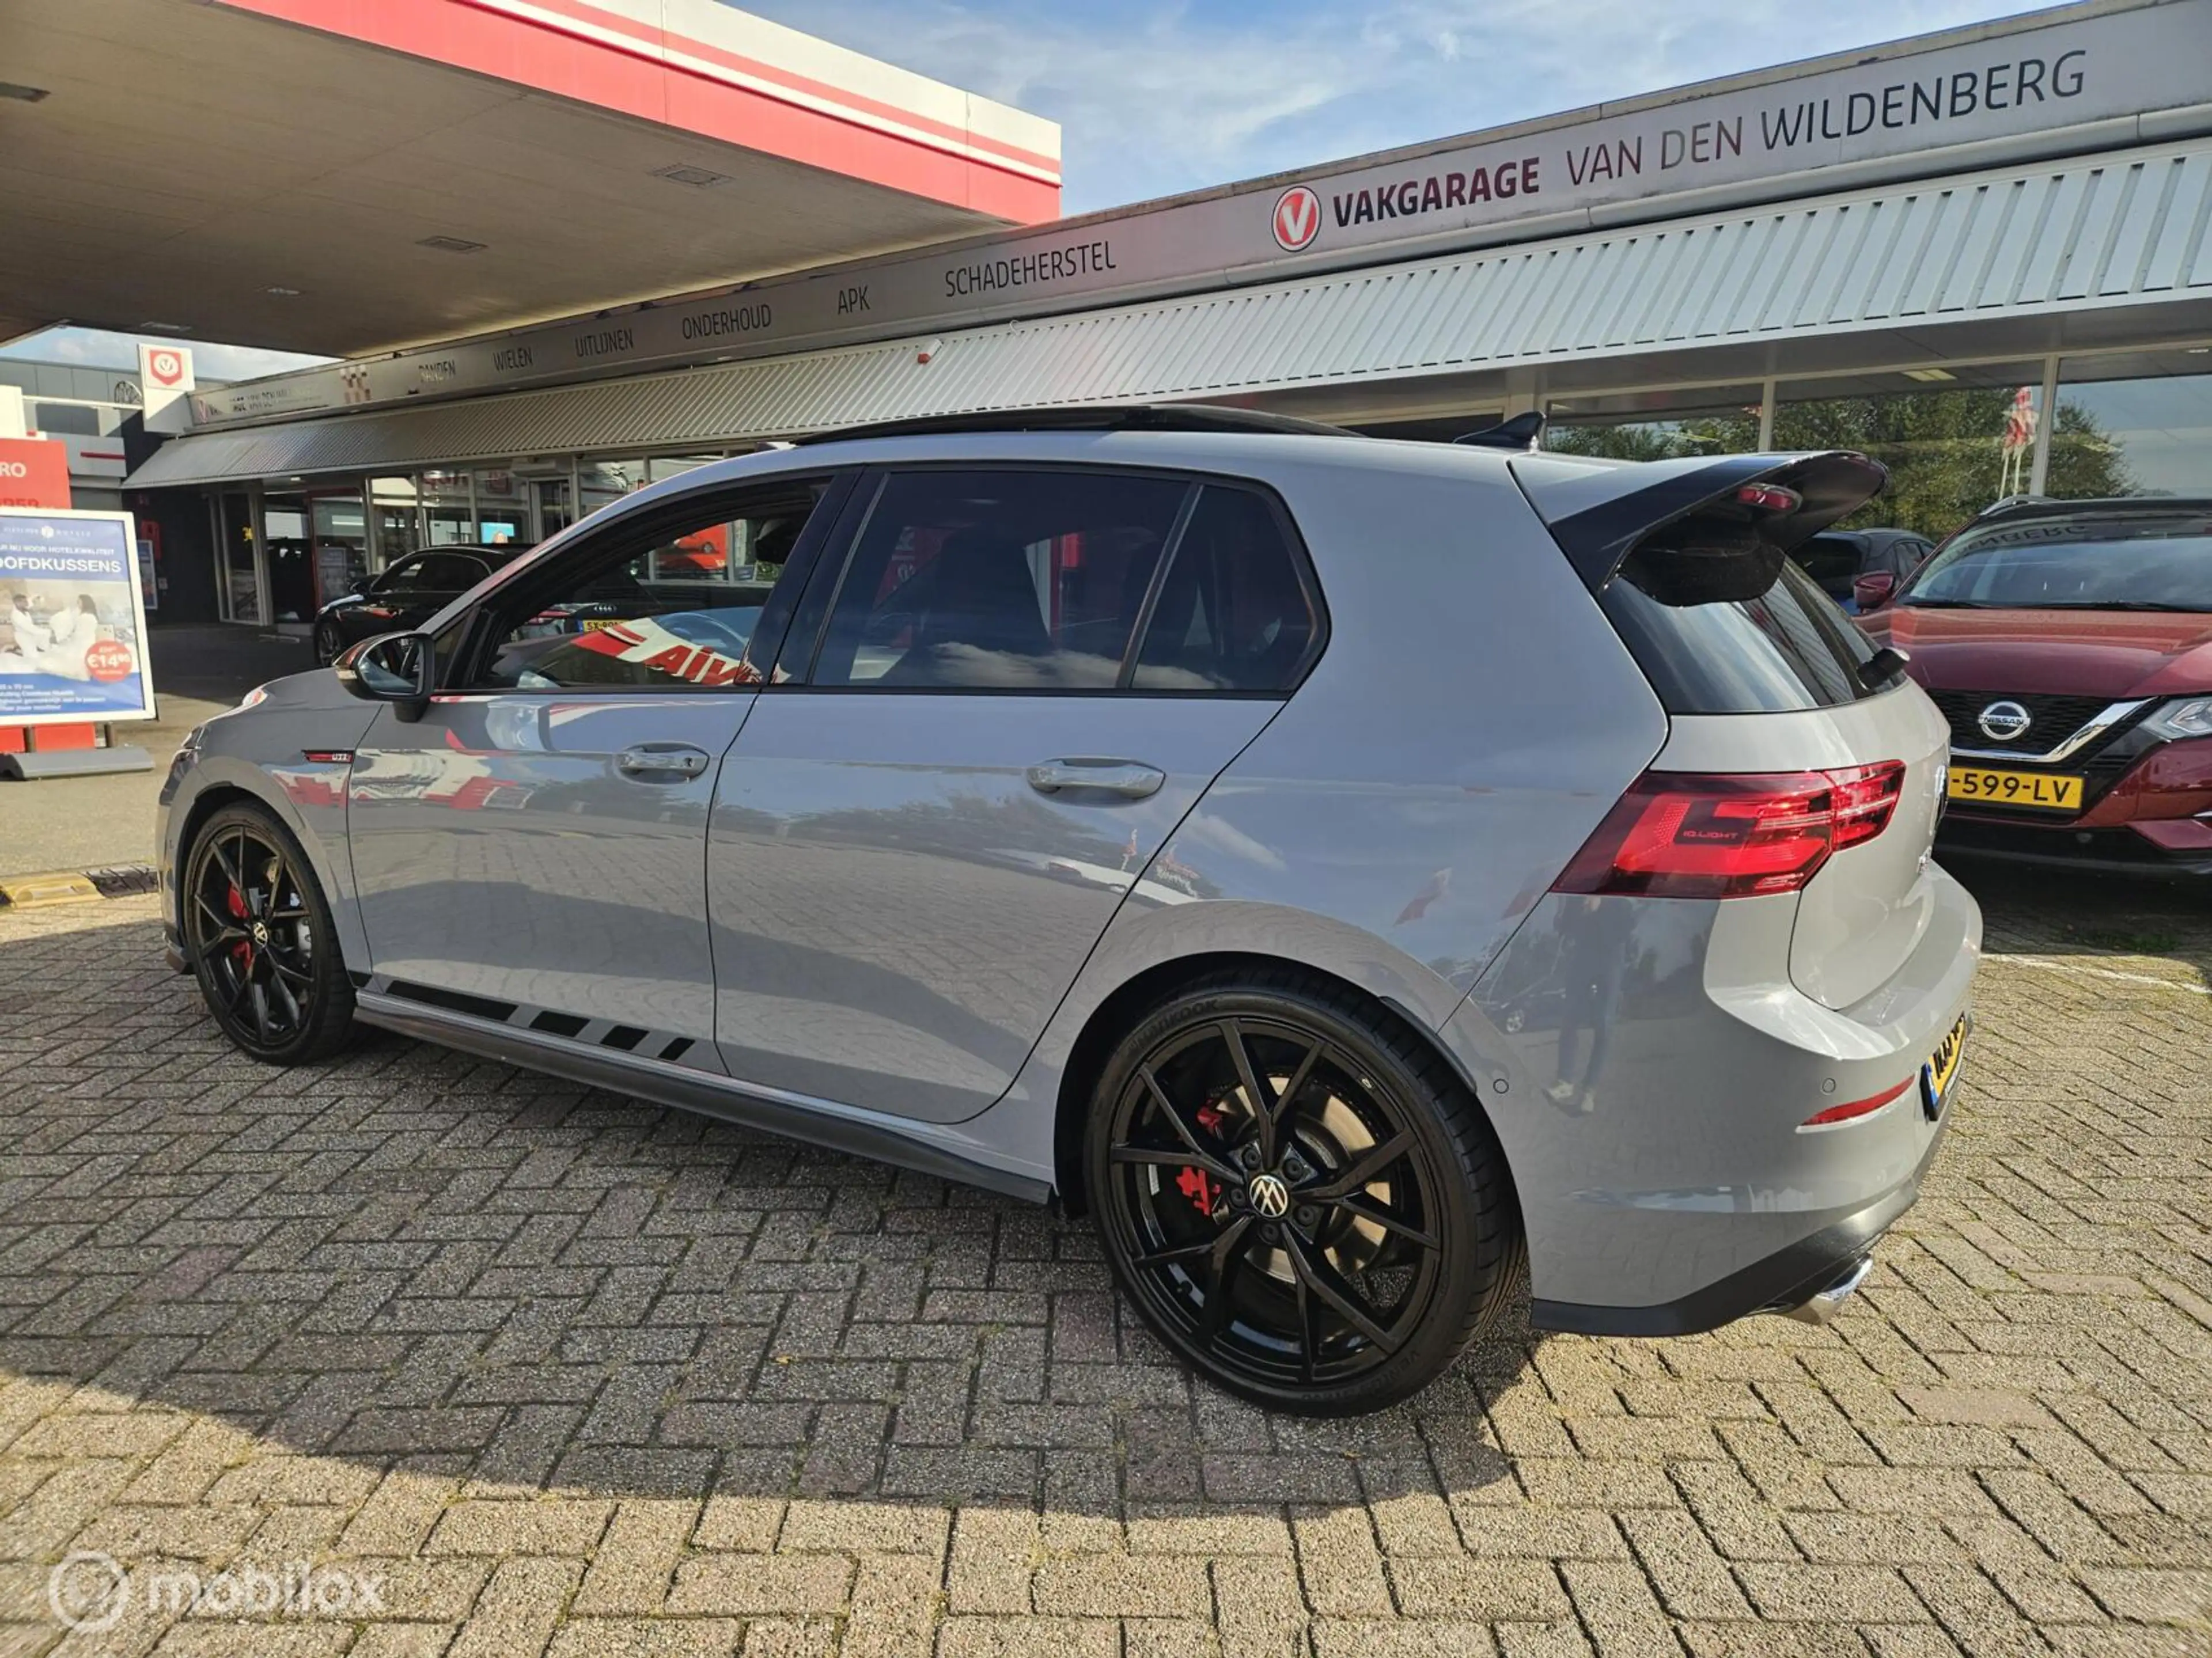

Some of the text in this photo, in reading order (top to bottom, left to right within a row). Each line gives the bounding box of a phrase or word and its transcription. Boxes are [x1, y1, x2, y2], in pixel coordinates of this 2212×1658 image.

[1333, 50, 2087, 227] VAKGARAGE VAN DEN WILDENBERG
[945, 241, 1117, 298] SCHADEHERSTEL
[838, 286, 870, 315] APK
[682, 304, 771, 340] ONDERHOUD
[493, 347, 533, 373] WIELEN
[1983, 715, 2024, 726] NISSAN
